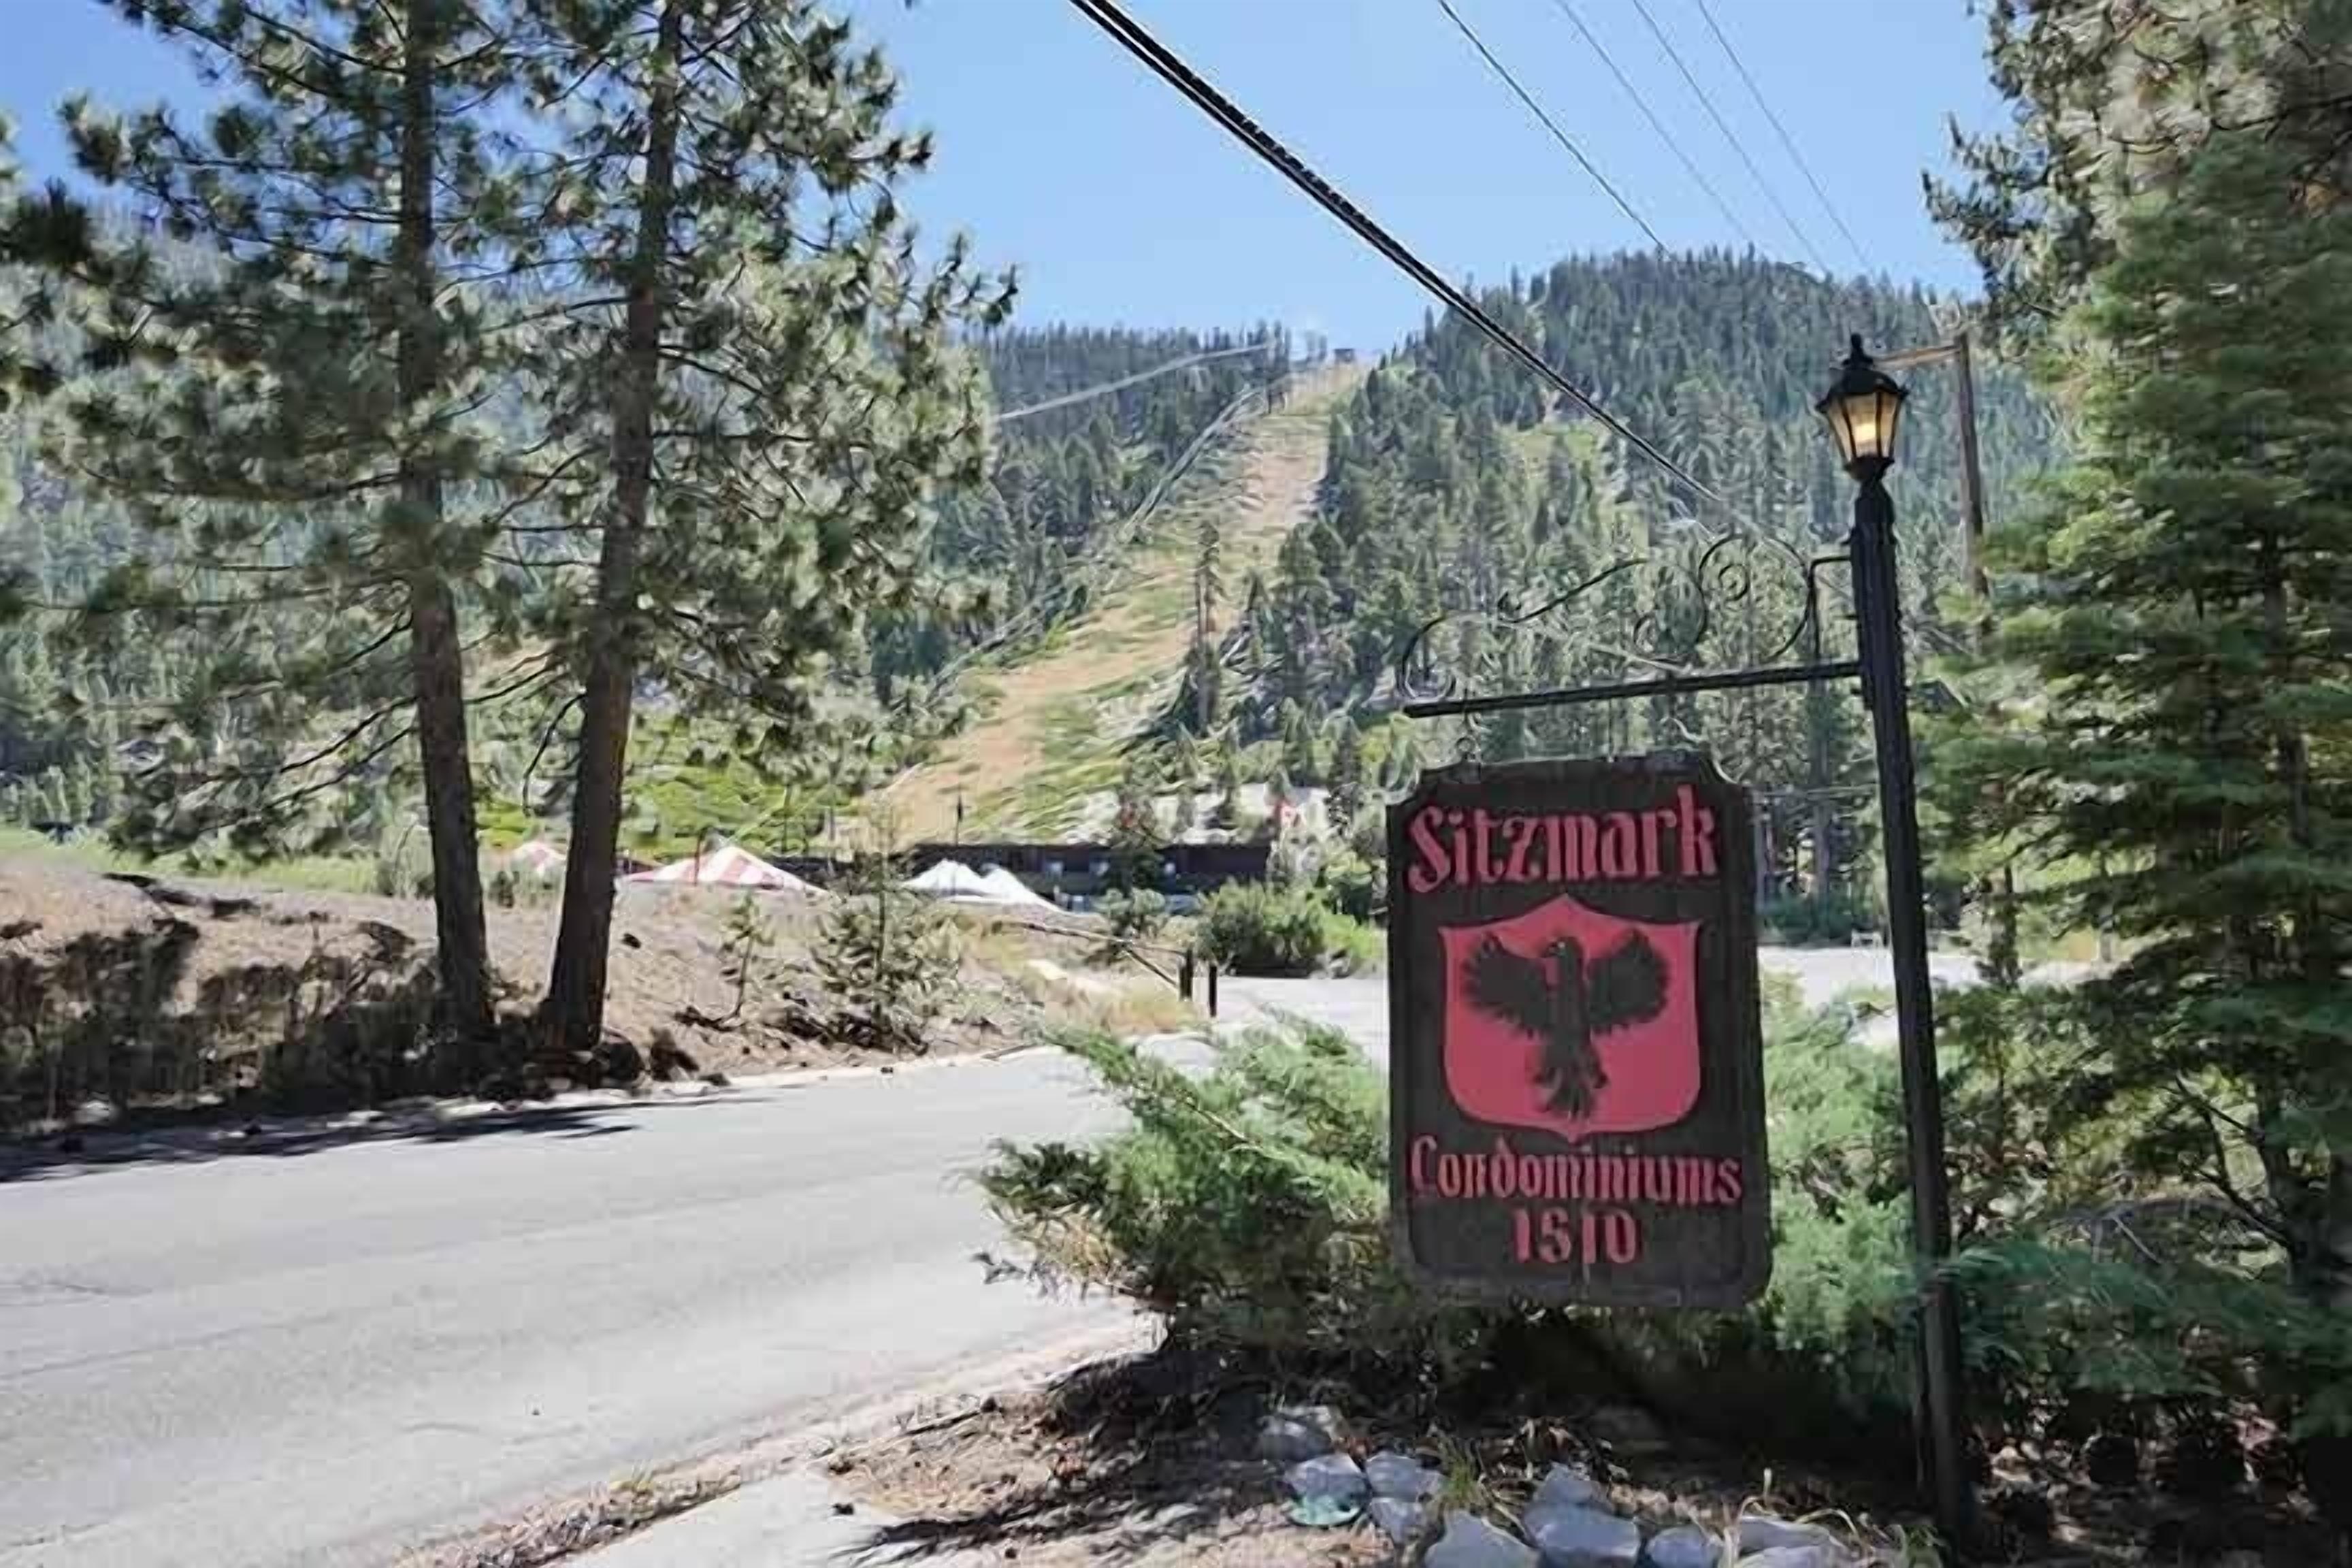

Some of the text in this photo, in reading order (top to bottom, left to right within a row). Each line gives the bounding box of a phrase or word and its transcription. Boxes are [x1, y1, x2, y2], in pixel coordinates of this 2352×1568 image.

[1407, 784, 1718, 893] Sitzmark
[1410, 1134, 1742, 1205] Condominiums
[1512, 1207, 1637, 1264] 1510
